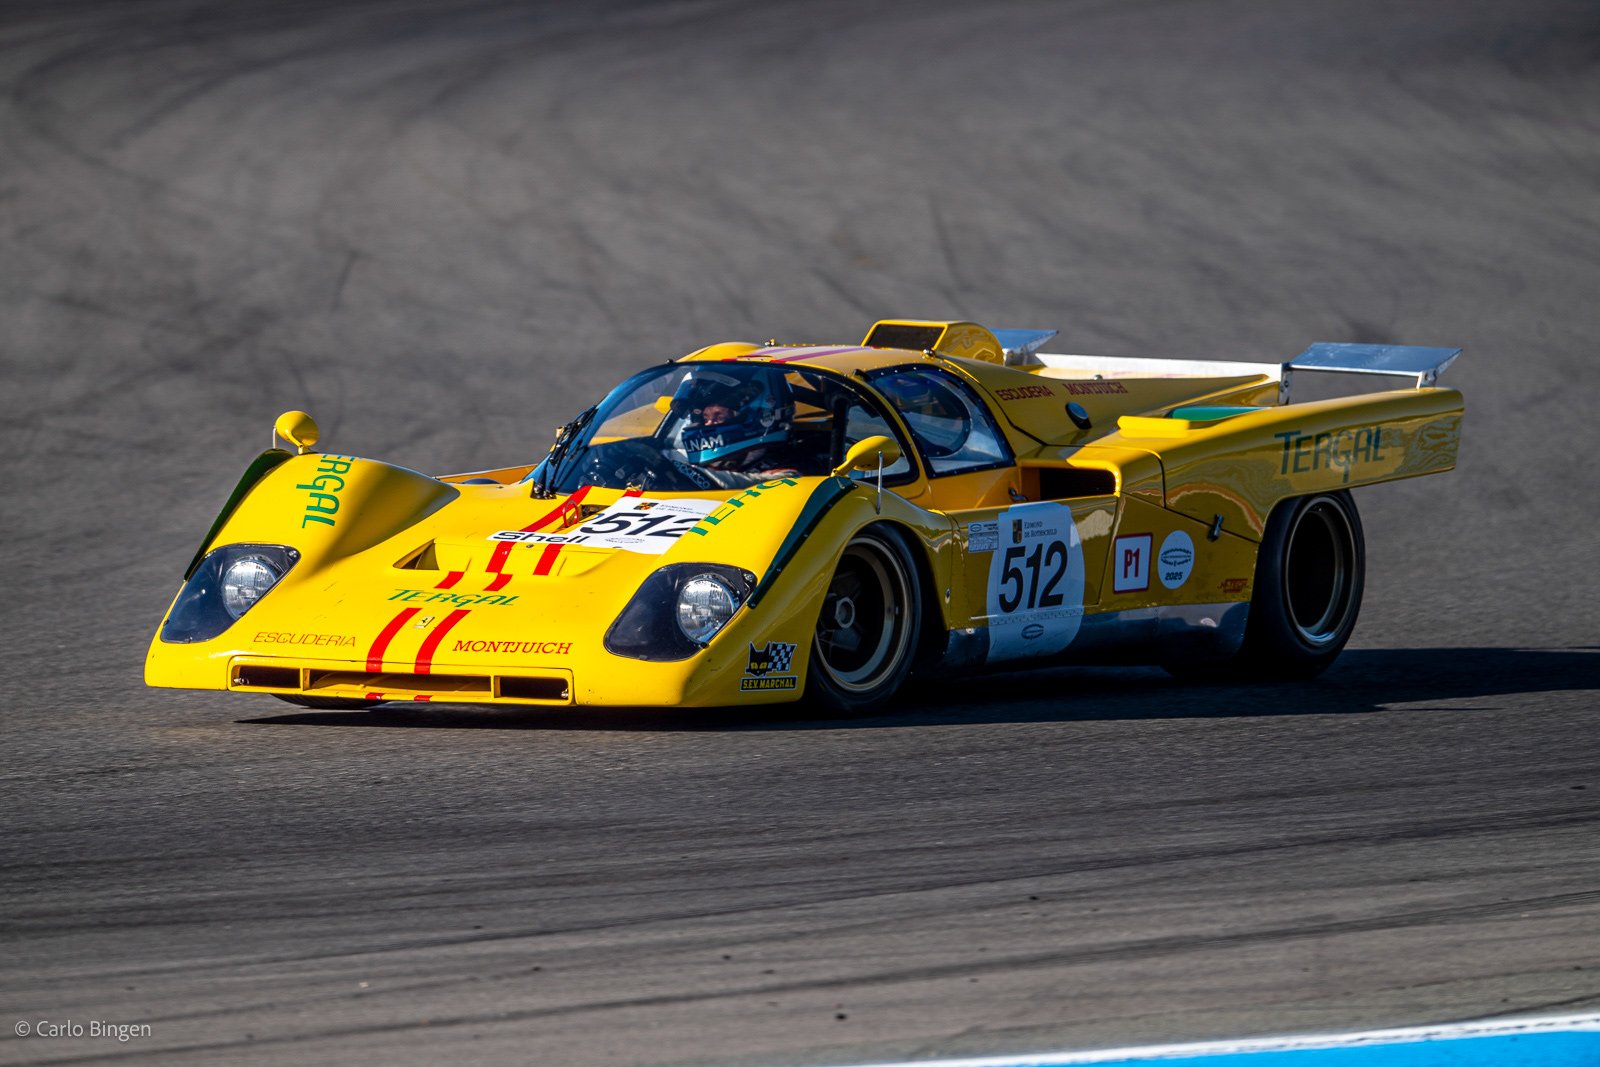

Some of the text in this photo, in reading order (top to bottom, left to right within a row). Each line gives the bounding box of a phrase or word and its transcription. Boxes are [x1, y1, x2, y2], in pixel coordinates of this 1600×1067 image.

[995, 385, 1055, 401] ESCUDERIA
[1274, 426, 1385, 483] TERGAL
[580, 512, 704, 537] 512
[493, 531, 590, 543] Shell
[1123, 548, 1140, 579] P1
[998, 540, 1068, 613] 512
[1165, 571, 1183, 581] 2025
[387, 588, 520, 608] TERGAL
[252, 631, 356, 647] ESCUDERIA
[452, 640, 573, 655] MONTJUICH
[760, 678, 794, 688] MARCHAL
